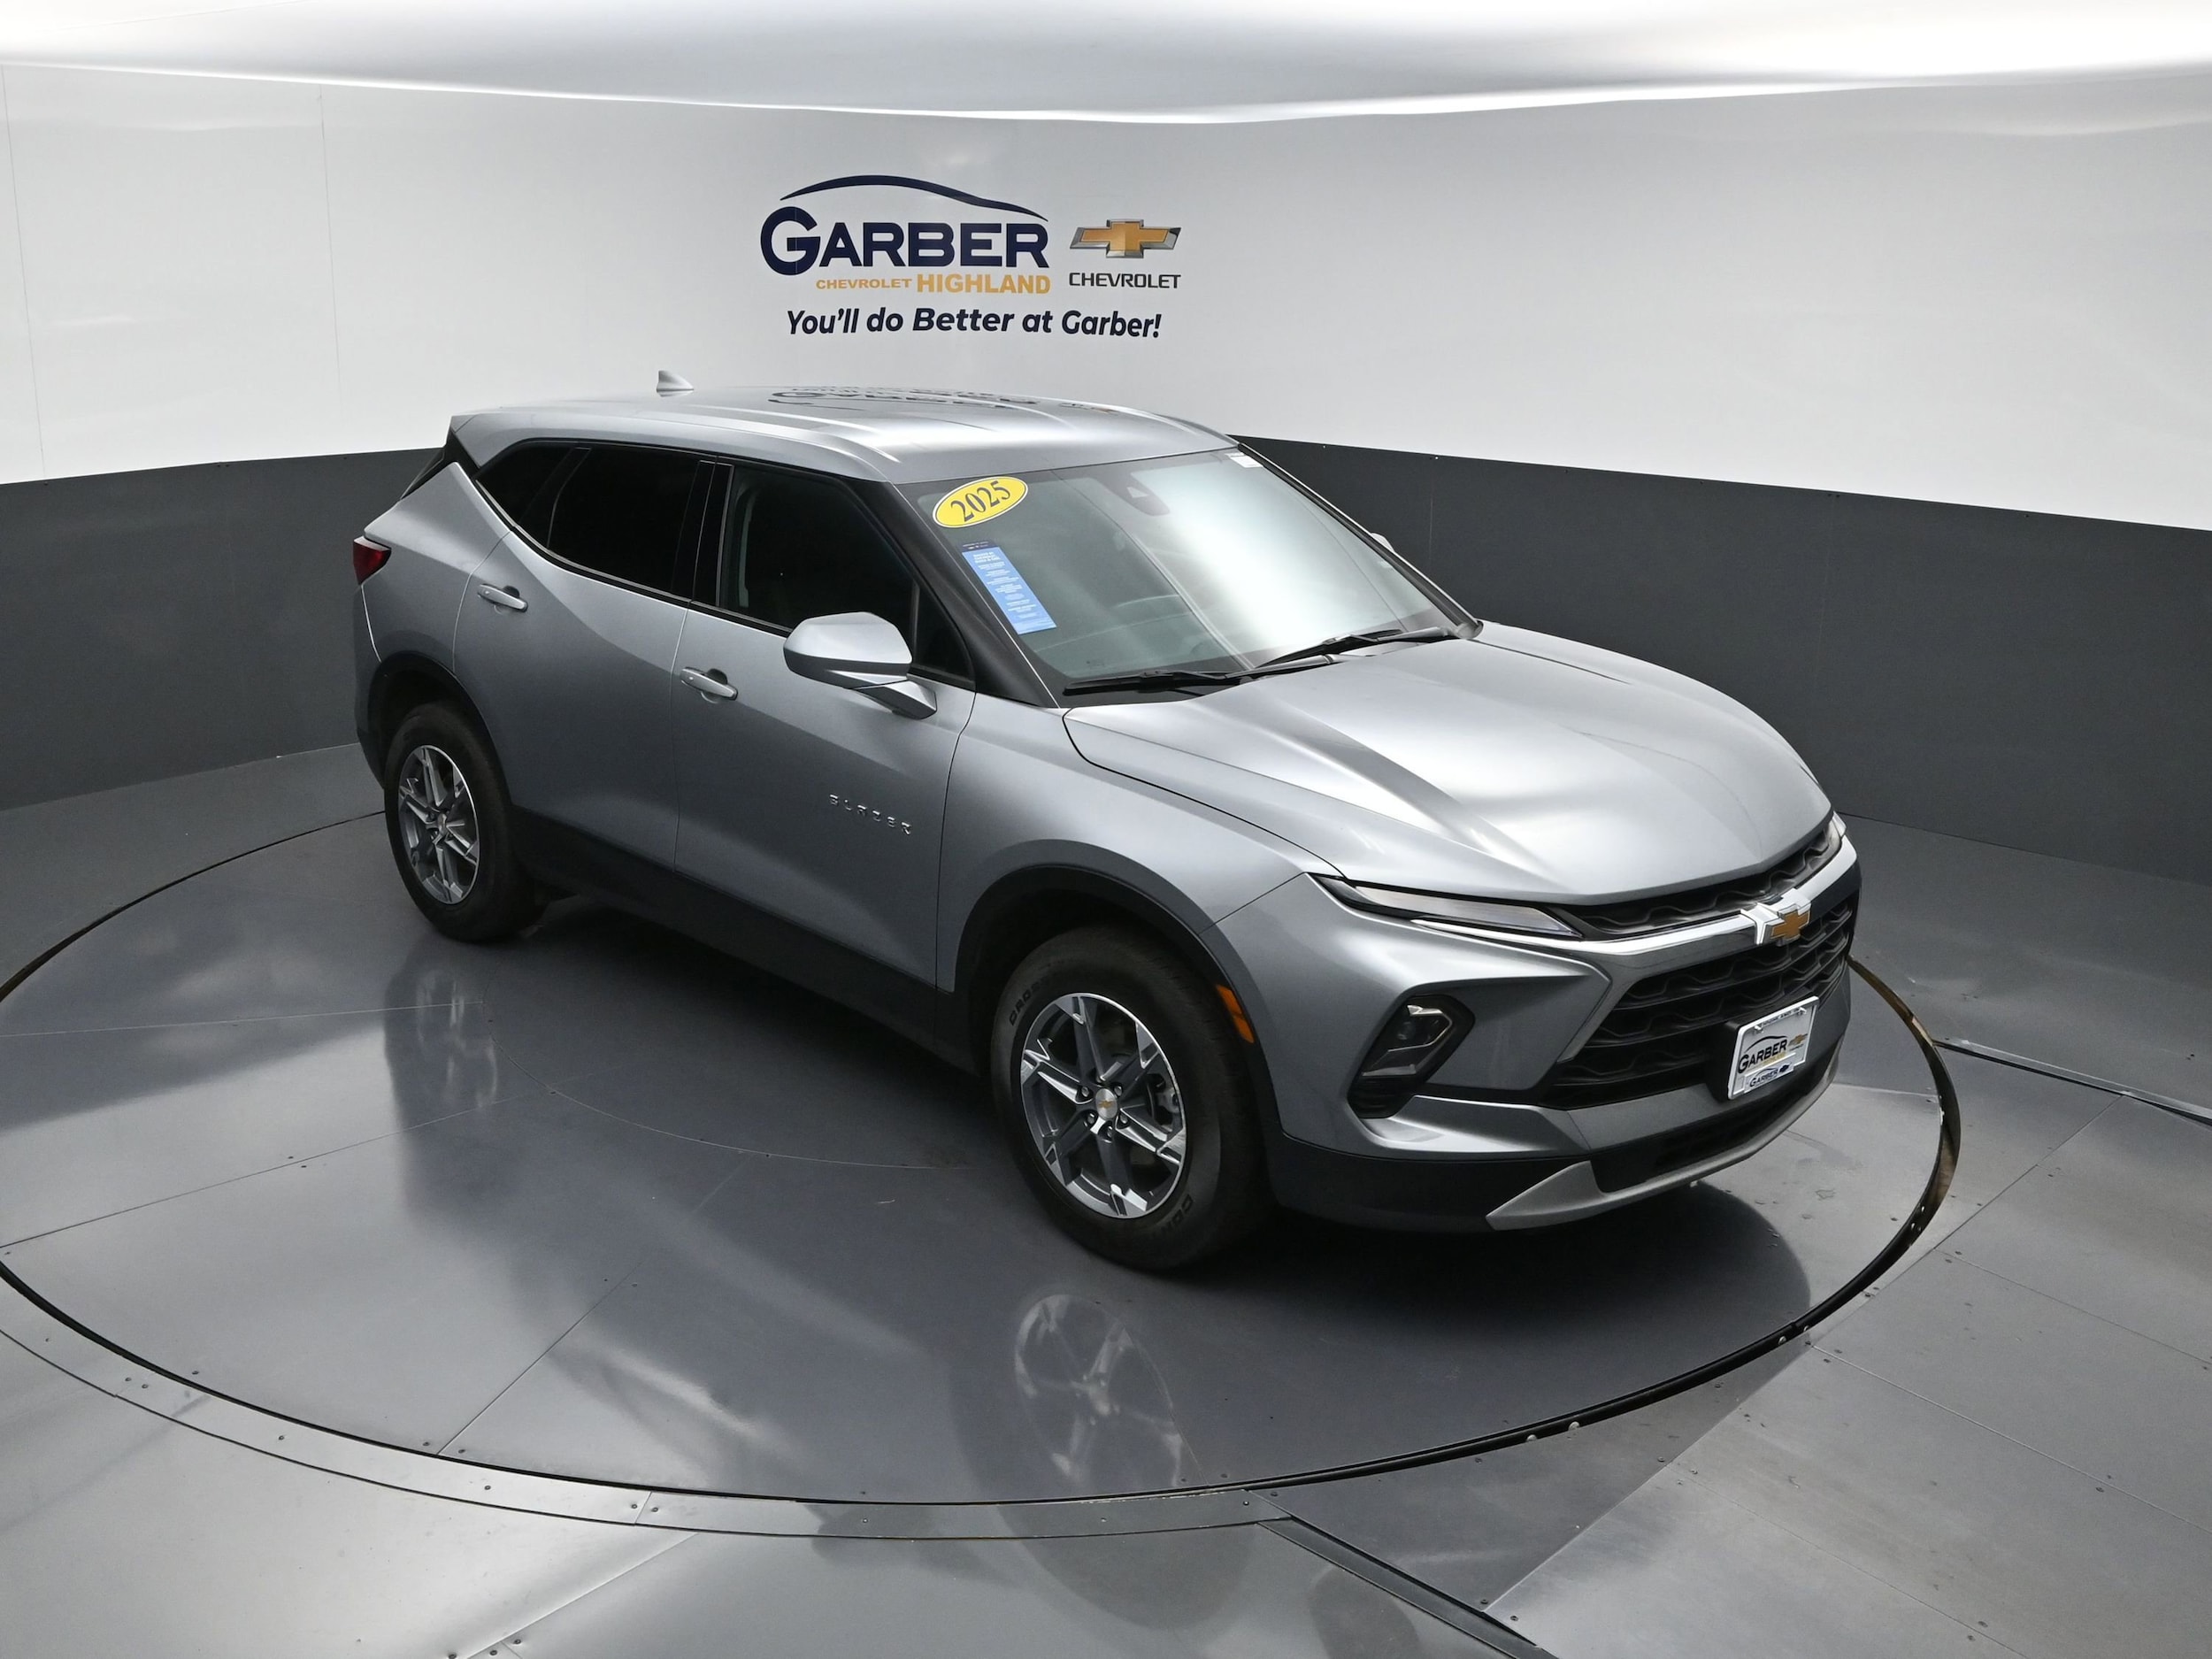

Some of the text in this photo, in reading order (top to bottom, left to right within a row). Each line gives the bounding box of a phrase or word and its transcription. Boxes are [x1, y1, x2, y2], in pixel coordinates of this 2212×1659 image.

[760, 206, 1049, 276] GARBER
[816, 273, 1050, 294] CHEVROLET HIGHLAND
[1069, 272, 1181, 289] CHEVROLET
[787, 307, 1162, 338] You'll do Better at Garber!
[950, 480, 1010, 522] 2025
[1738, 1039, 1787, 1073] GARBER
